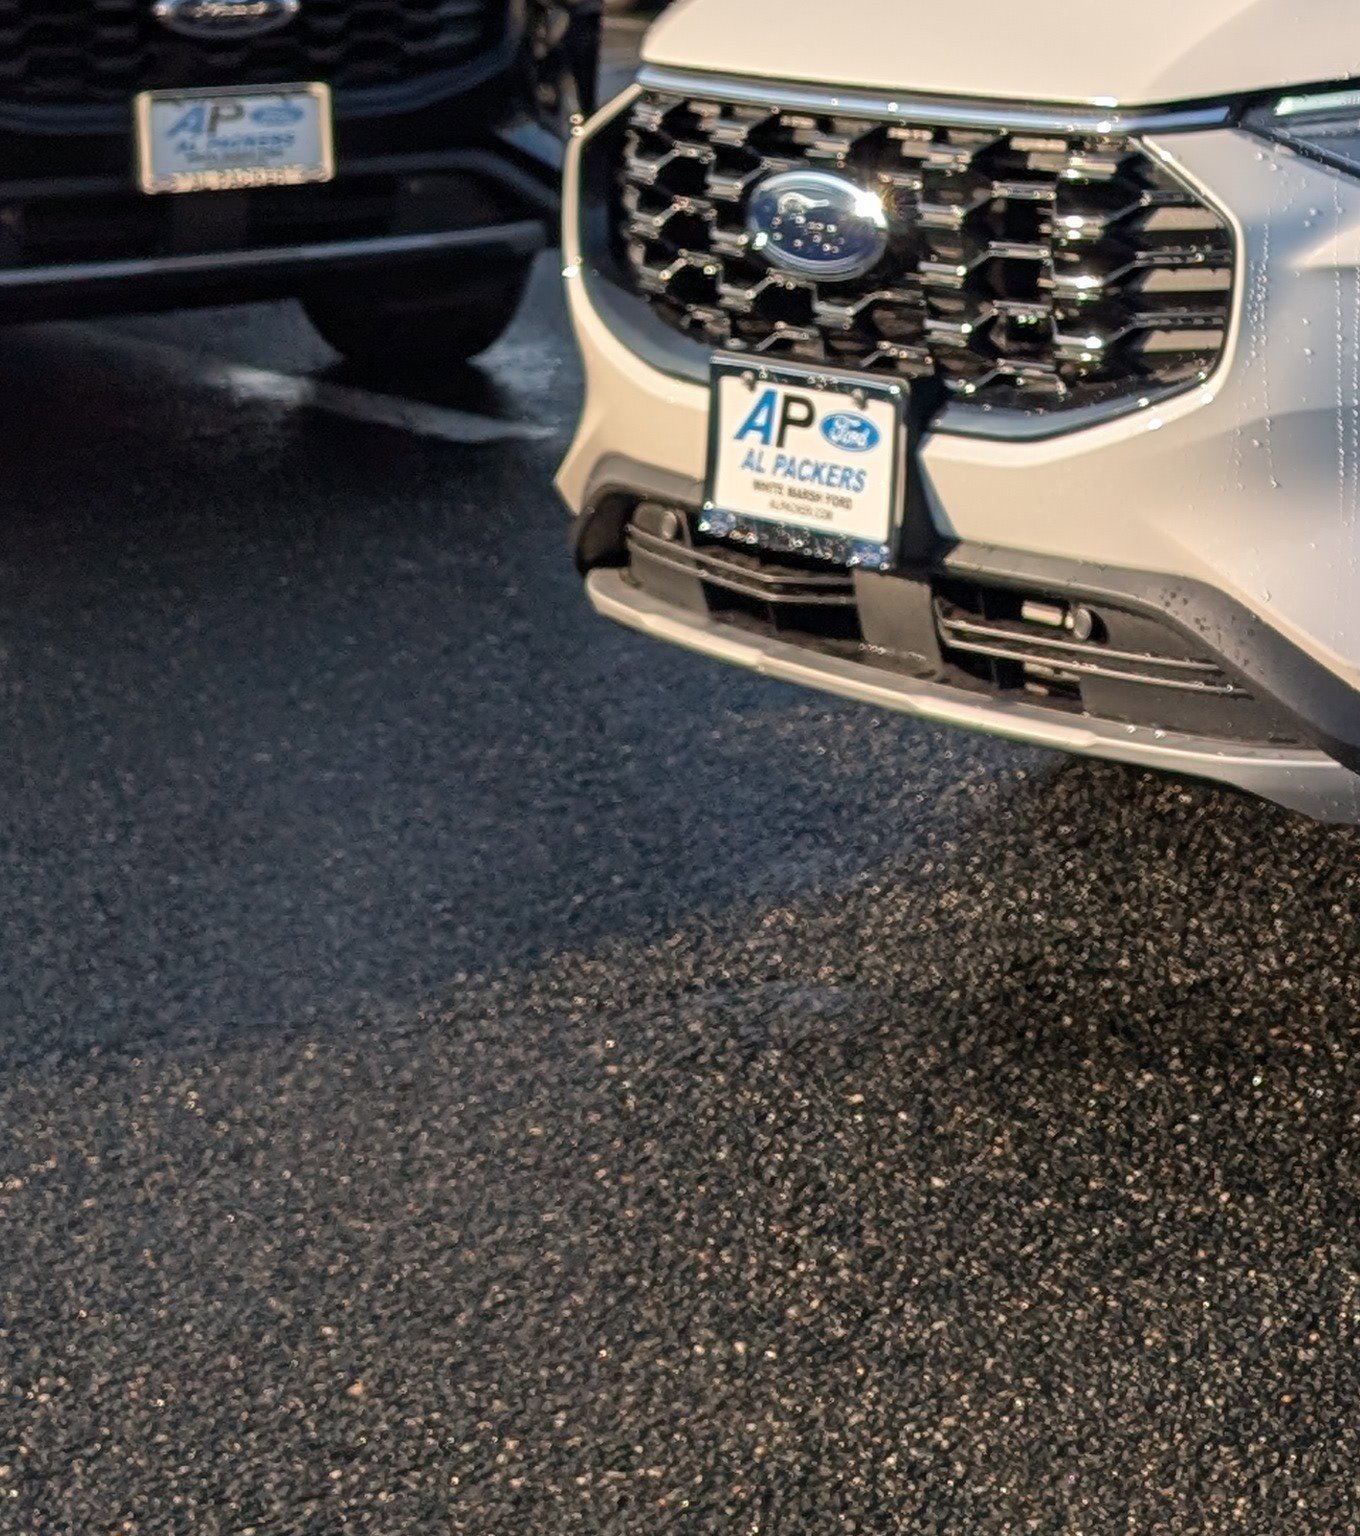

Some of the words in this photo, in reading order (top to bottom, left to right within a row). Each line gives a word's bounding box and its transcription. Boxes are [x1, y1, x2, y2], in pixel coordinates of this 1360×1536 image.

[734, 389, 815, 448] AP
[741, 448, 765, 474] AL
[772, 453, 867, 494] PACKERS
